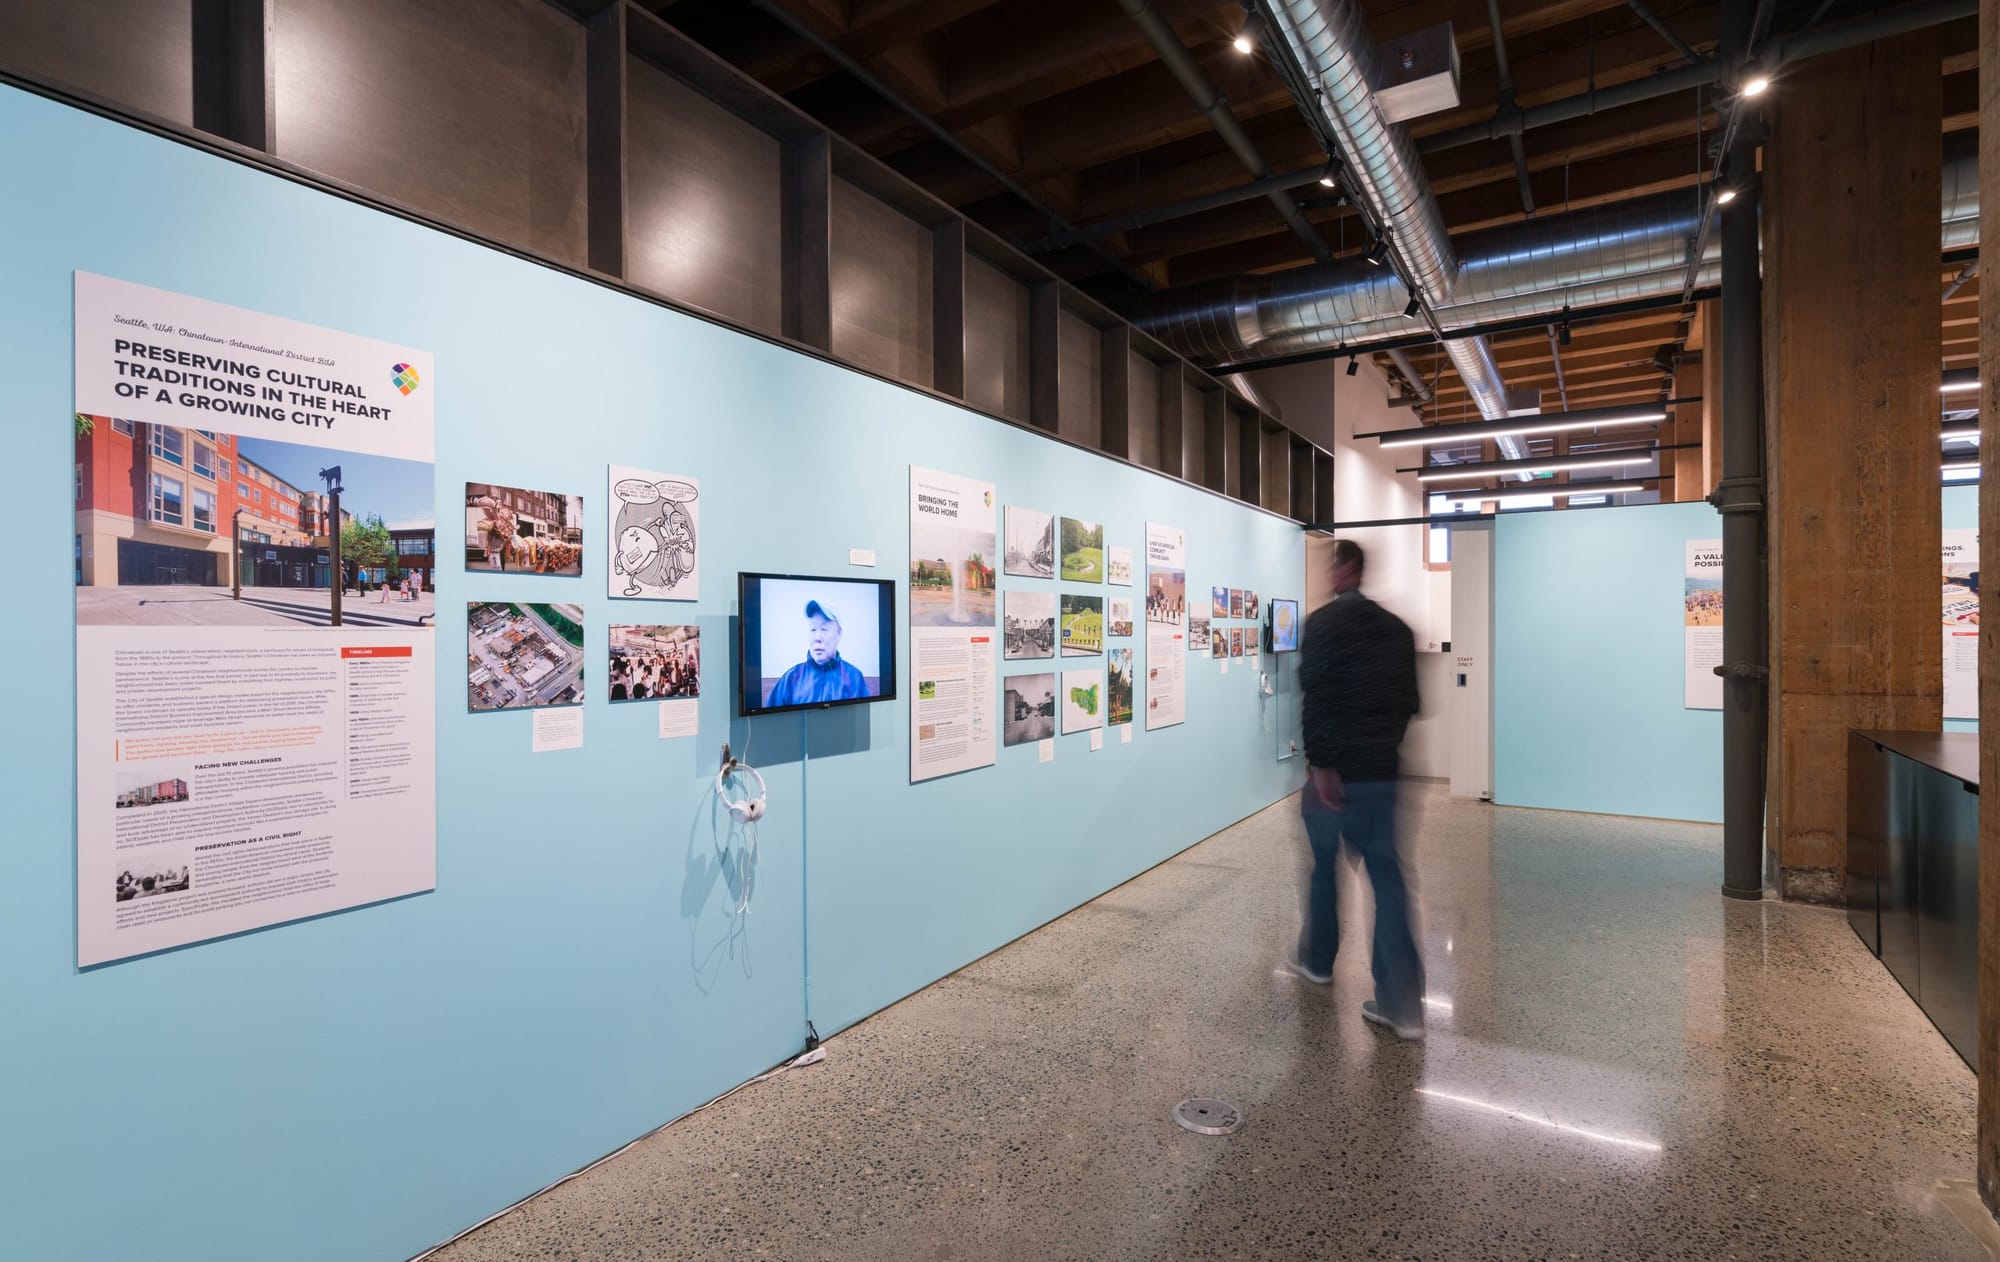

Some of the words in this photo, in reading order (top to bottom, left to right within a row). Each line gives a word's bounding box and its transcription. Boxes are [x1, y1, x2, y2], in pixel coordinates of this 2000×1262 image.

[113, 313, 149, 330] Seattle,
[286, 350, 315, 363] District
[114, 338, 261, 379] PRESERVING
[266, 368, 366, 399] CULTURAL
[114, 359, 256, 397] TRADITIONS
[262, 385, 282, 402] IN
[288, 390, 326, 409] THE
[332, 398, 391, 420] HEART
[114, 381, 148, 399] OF
[154, 388, 172, 404] A
[178, 392, 285, 421] GROWING
[291, 410, 335, 429] CITY
[918, 494, 946, 506] BRINGING
[948, 500, 959, 508] THE
[918, 504, 940, 515] WORLD
[941, 508, 958, 518] HOME
[240, 757, 282, 766] CHALLENGES
[195, 840, 247, 851] PRESERVATION
